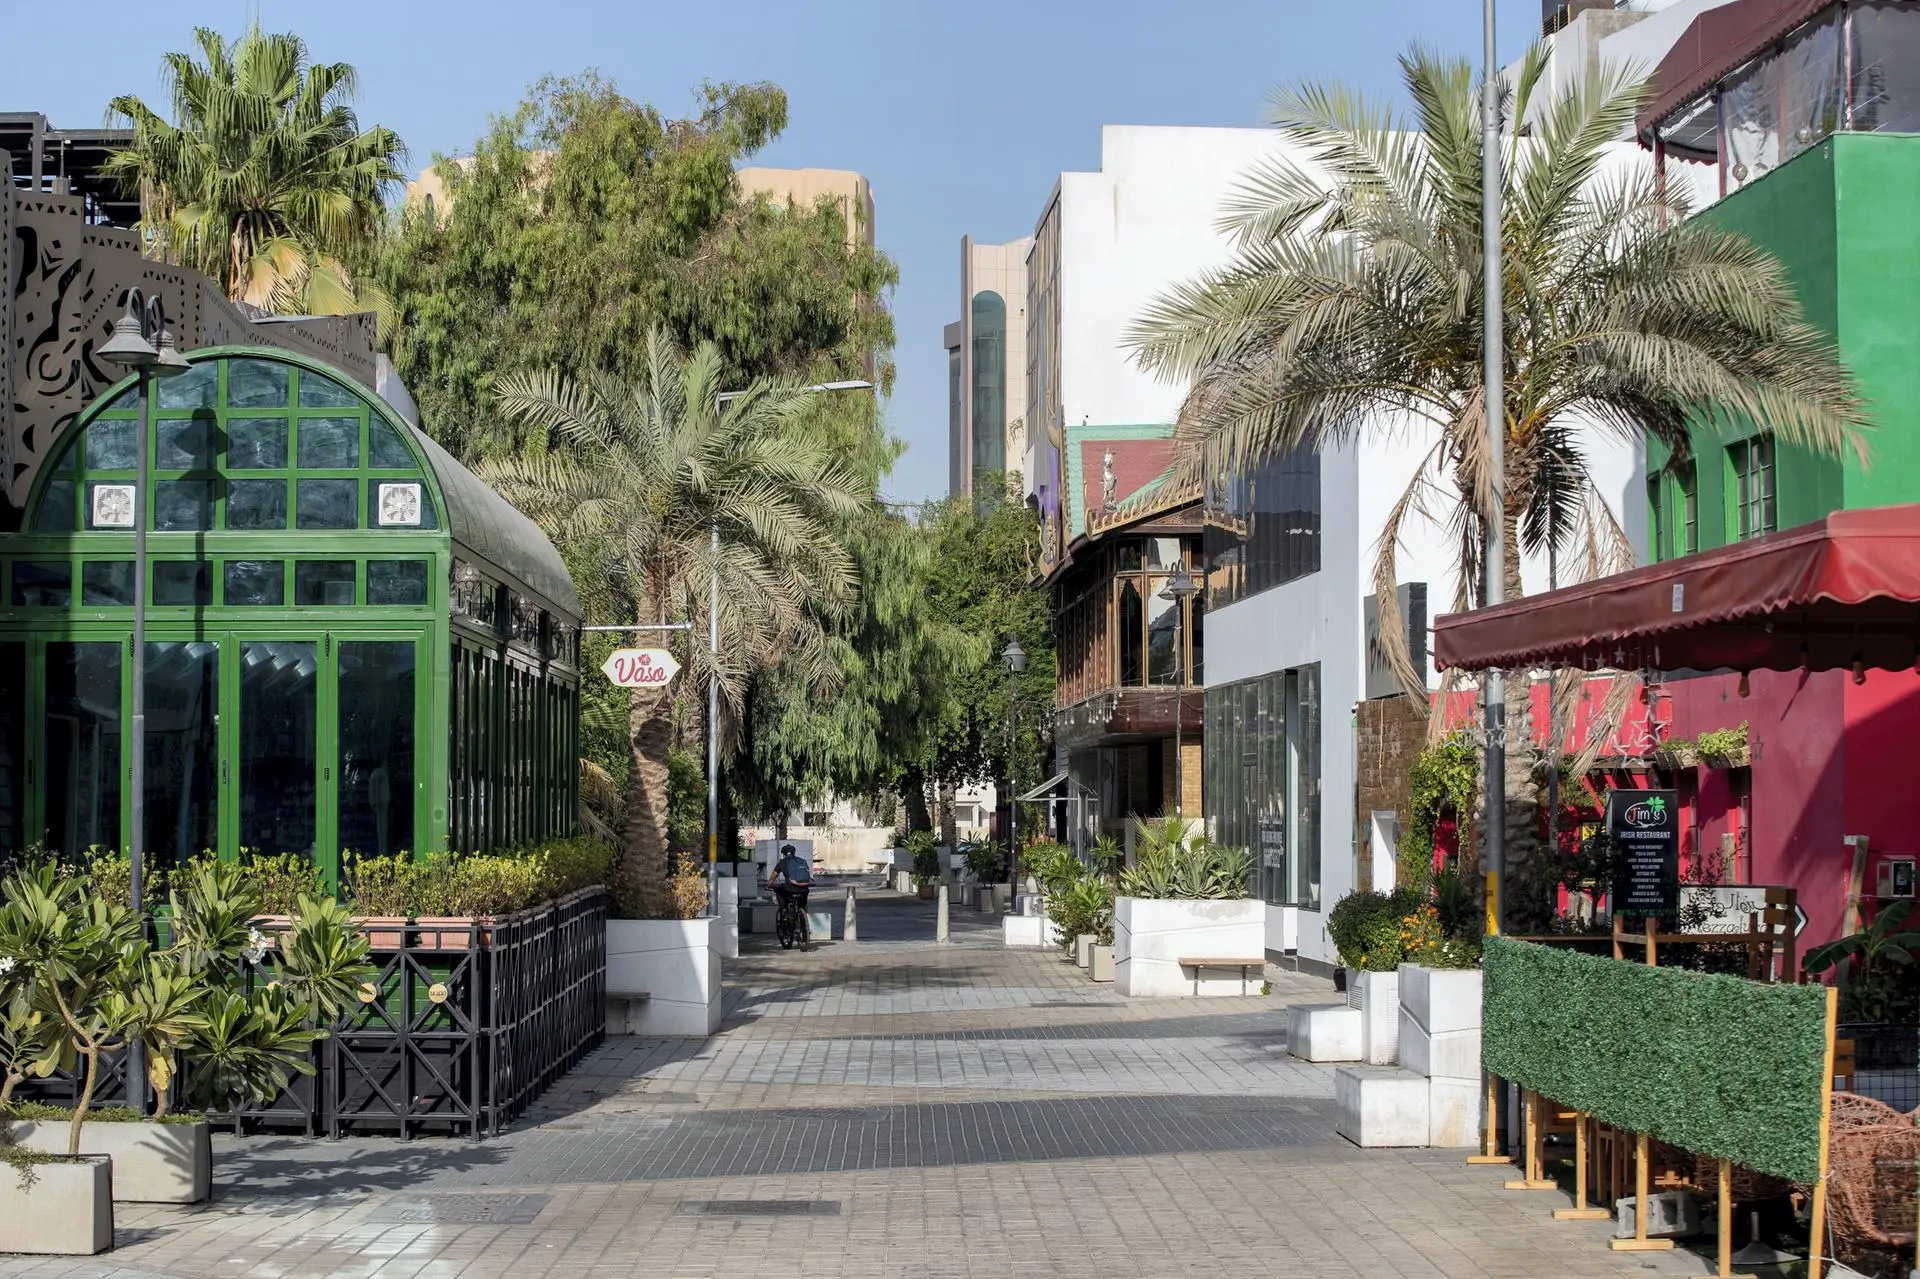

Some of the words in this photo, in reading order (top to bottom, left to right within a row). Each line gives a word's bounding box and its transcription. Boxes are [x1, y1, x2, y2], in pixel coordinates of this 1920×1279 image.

[1628, 806, 1660, 822] Jim's
[1620, 831, 1635, 839] IRISH
[1636, 831, 1671, 839] RESTAURANT
